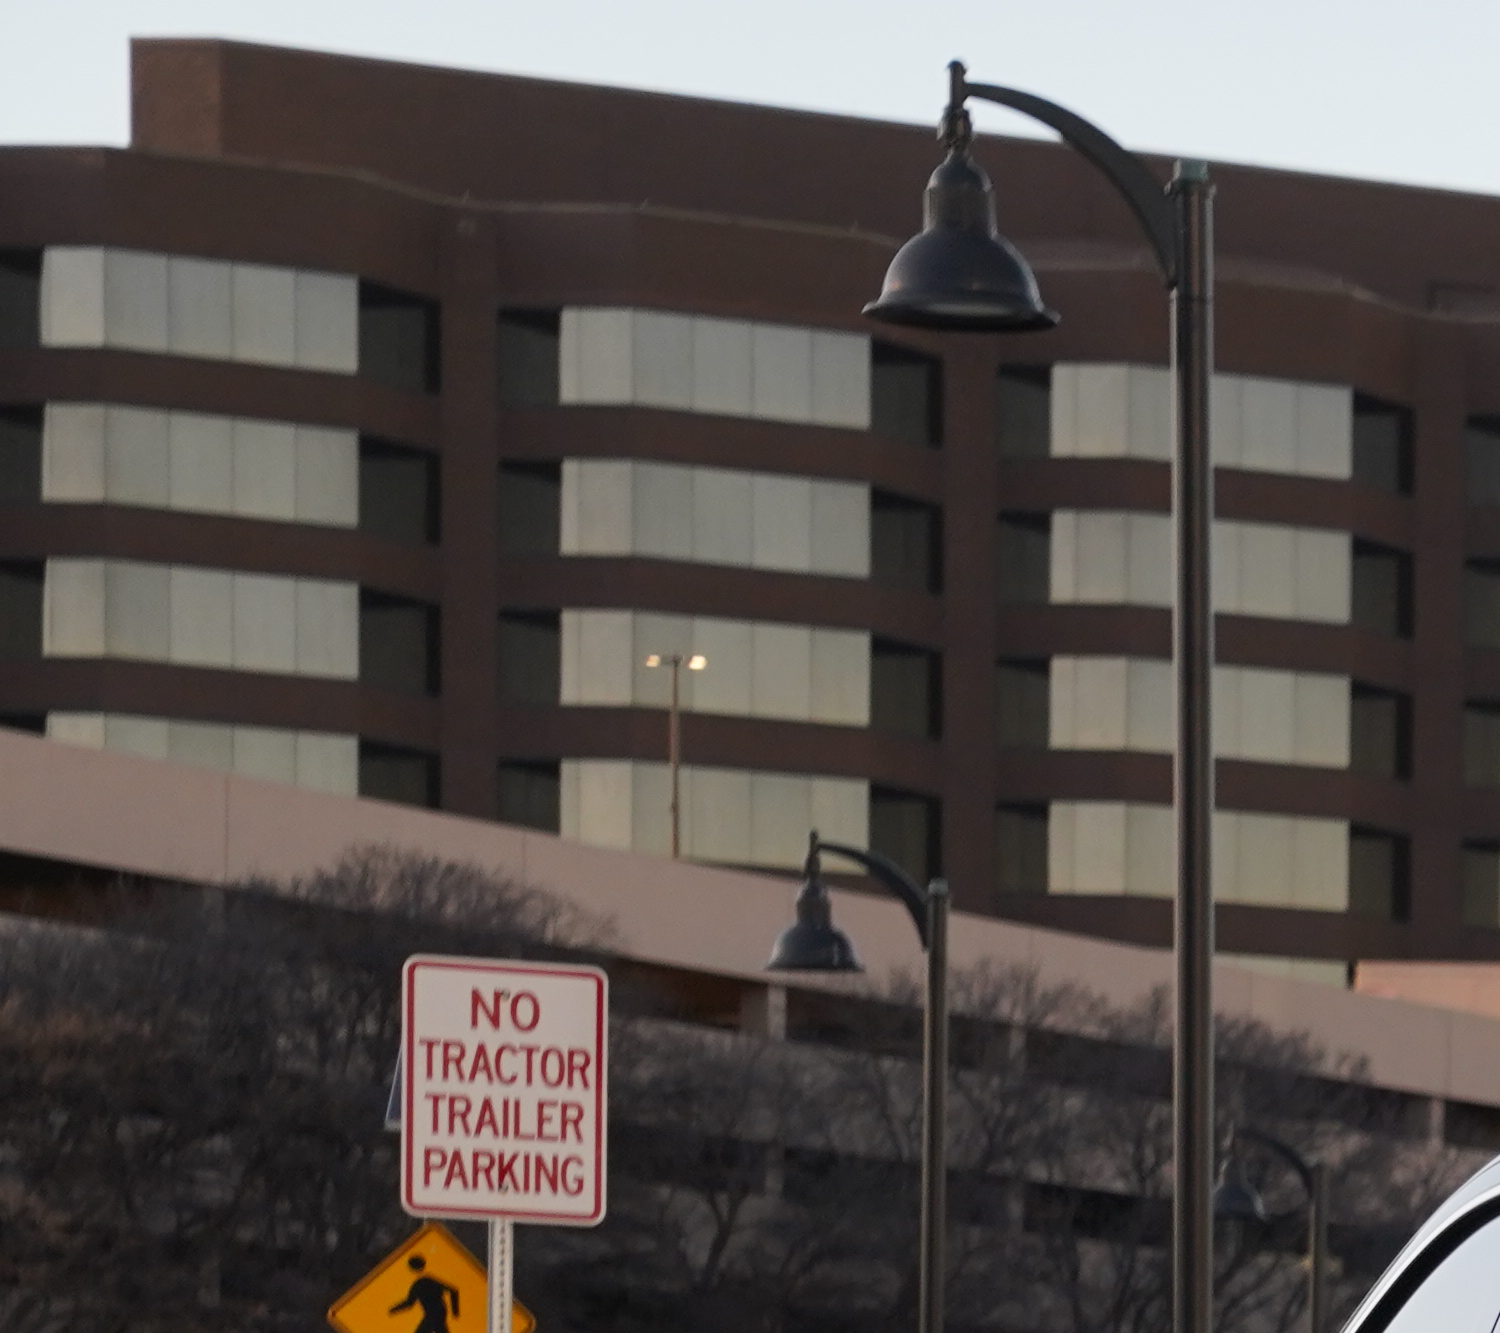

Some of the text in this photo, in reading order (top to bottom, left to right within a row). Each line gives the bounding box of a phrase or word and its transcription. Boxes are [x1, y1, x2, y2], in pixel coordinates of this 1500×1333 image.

[470, 986, 541, 1032] NO
[418, 1038, 592, 1091] TRACTOR
[424, 1091, 585, 1144] TRAILER
[422, 1146, 585, 1197] PARKING
